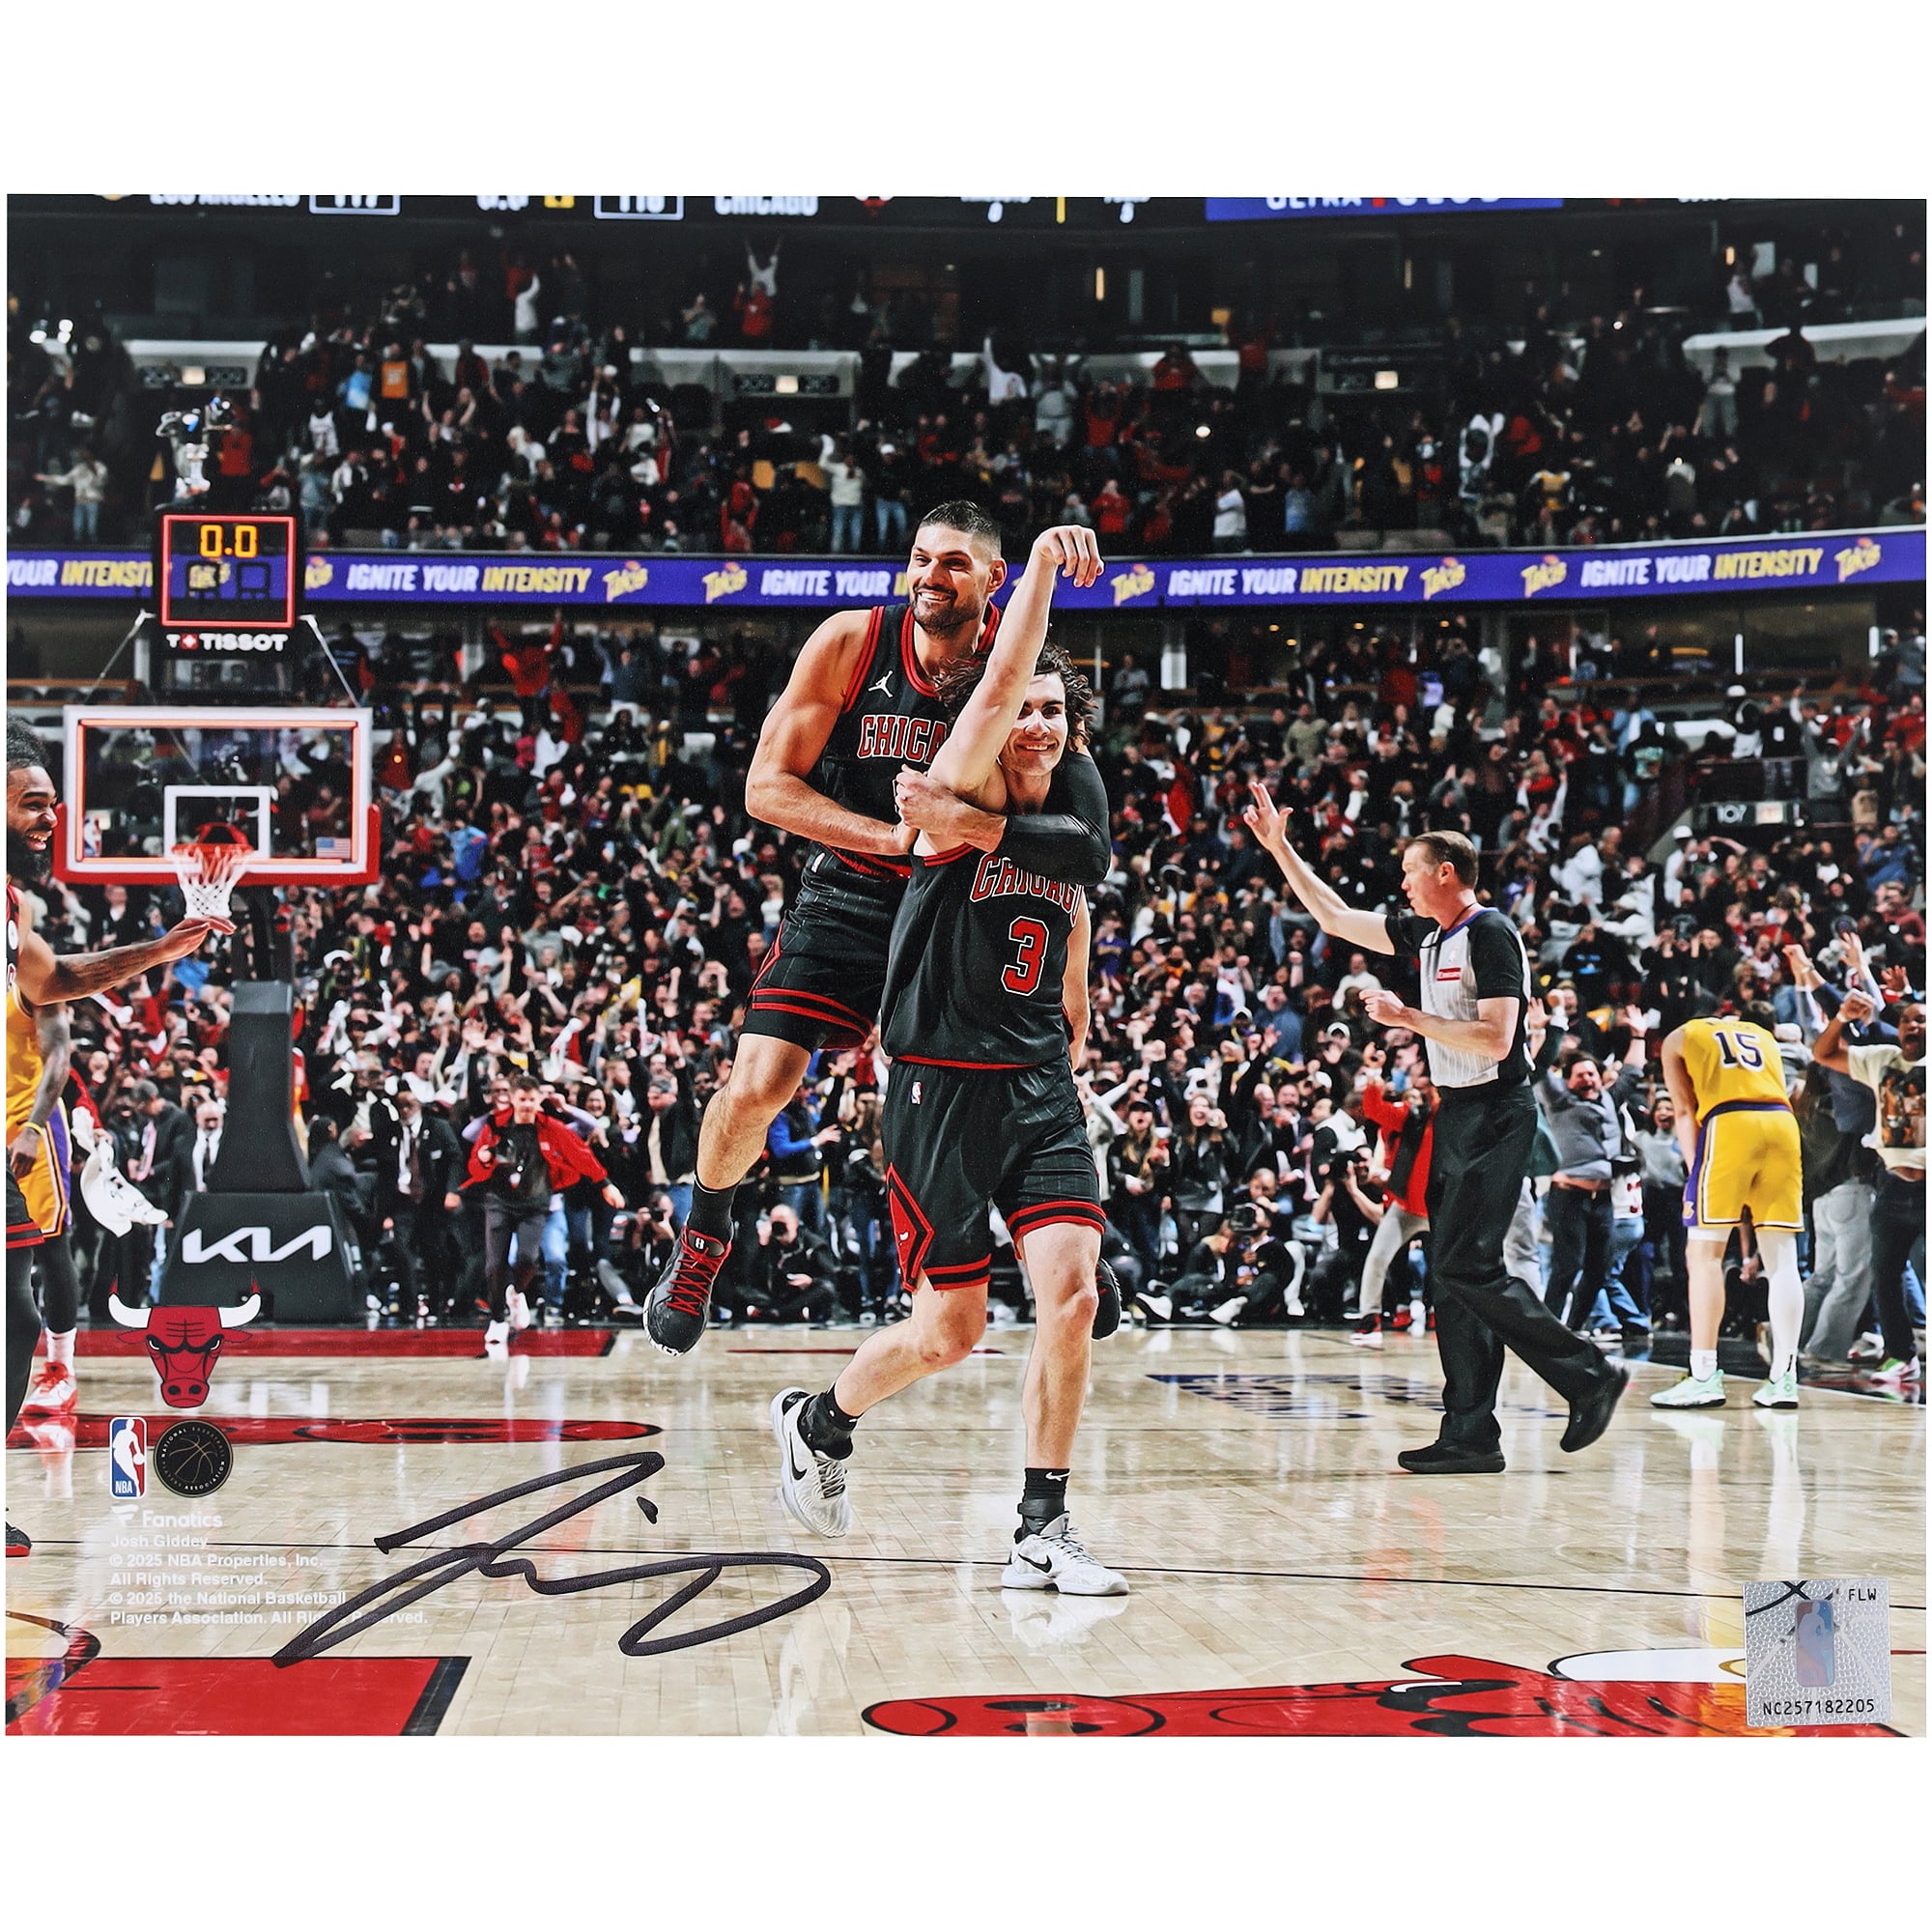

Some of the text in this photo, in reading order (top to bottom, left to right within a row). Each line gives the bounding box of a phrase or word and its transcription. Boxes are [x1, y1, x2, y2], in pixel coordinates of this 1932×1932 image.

[200, 525, 258, 557] 0.0
[7, 559, 58, 586] YOUR
[347, 565, 418, 591] IGNITE
[421, 566, 479, 591] YOUR
[482, 567, 592, 593] INTENSITY
[1168, 566, 1408, 595] IGNITE YOUR INTENSITY
[1580, 548, 1824, 587] IGNITE YOUR INTENSITY
[760, 570, 831, 596] IGNITE
[835, 570, 892, 597] YOUR
[199, 634, 288, 651] TISSOT
[857, 715, 950, 764] CHICA
[1717, 804, 1747, 823] 107
[970, 853, 1084, 927] CHICAG
[1001, 916, 1049, 997] 3
[1712, 1029, 1765, 1072] 15
[182, 1225, 332, 1264] KIA
[1848, 1588, 1877, 1602] FLW
[1763, 1698, 1875, 1716] NC257182205
